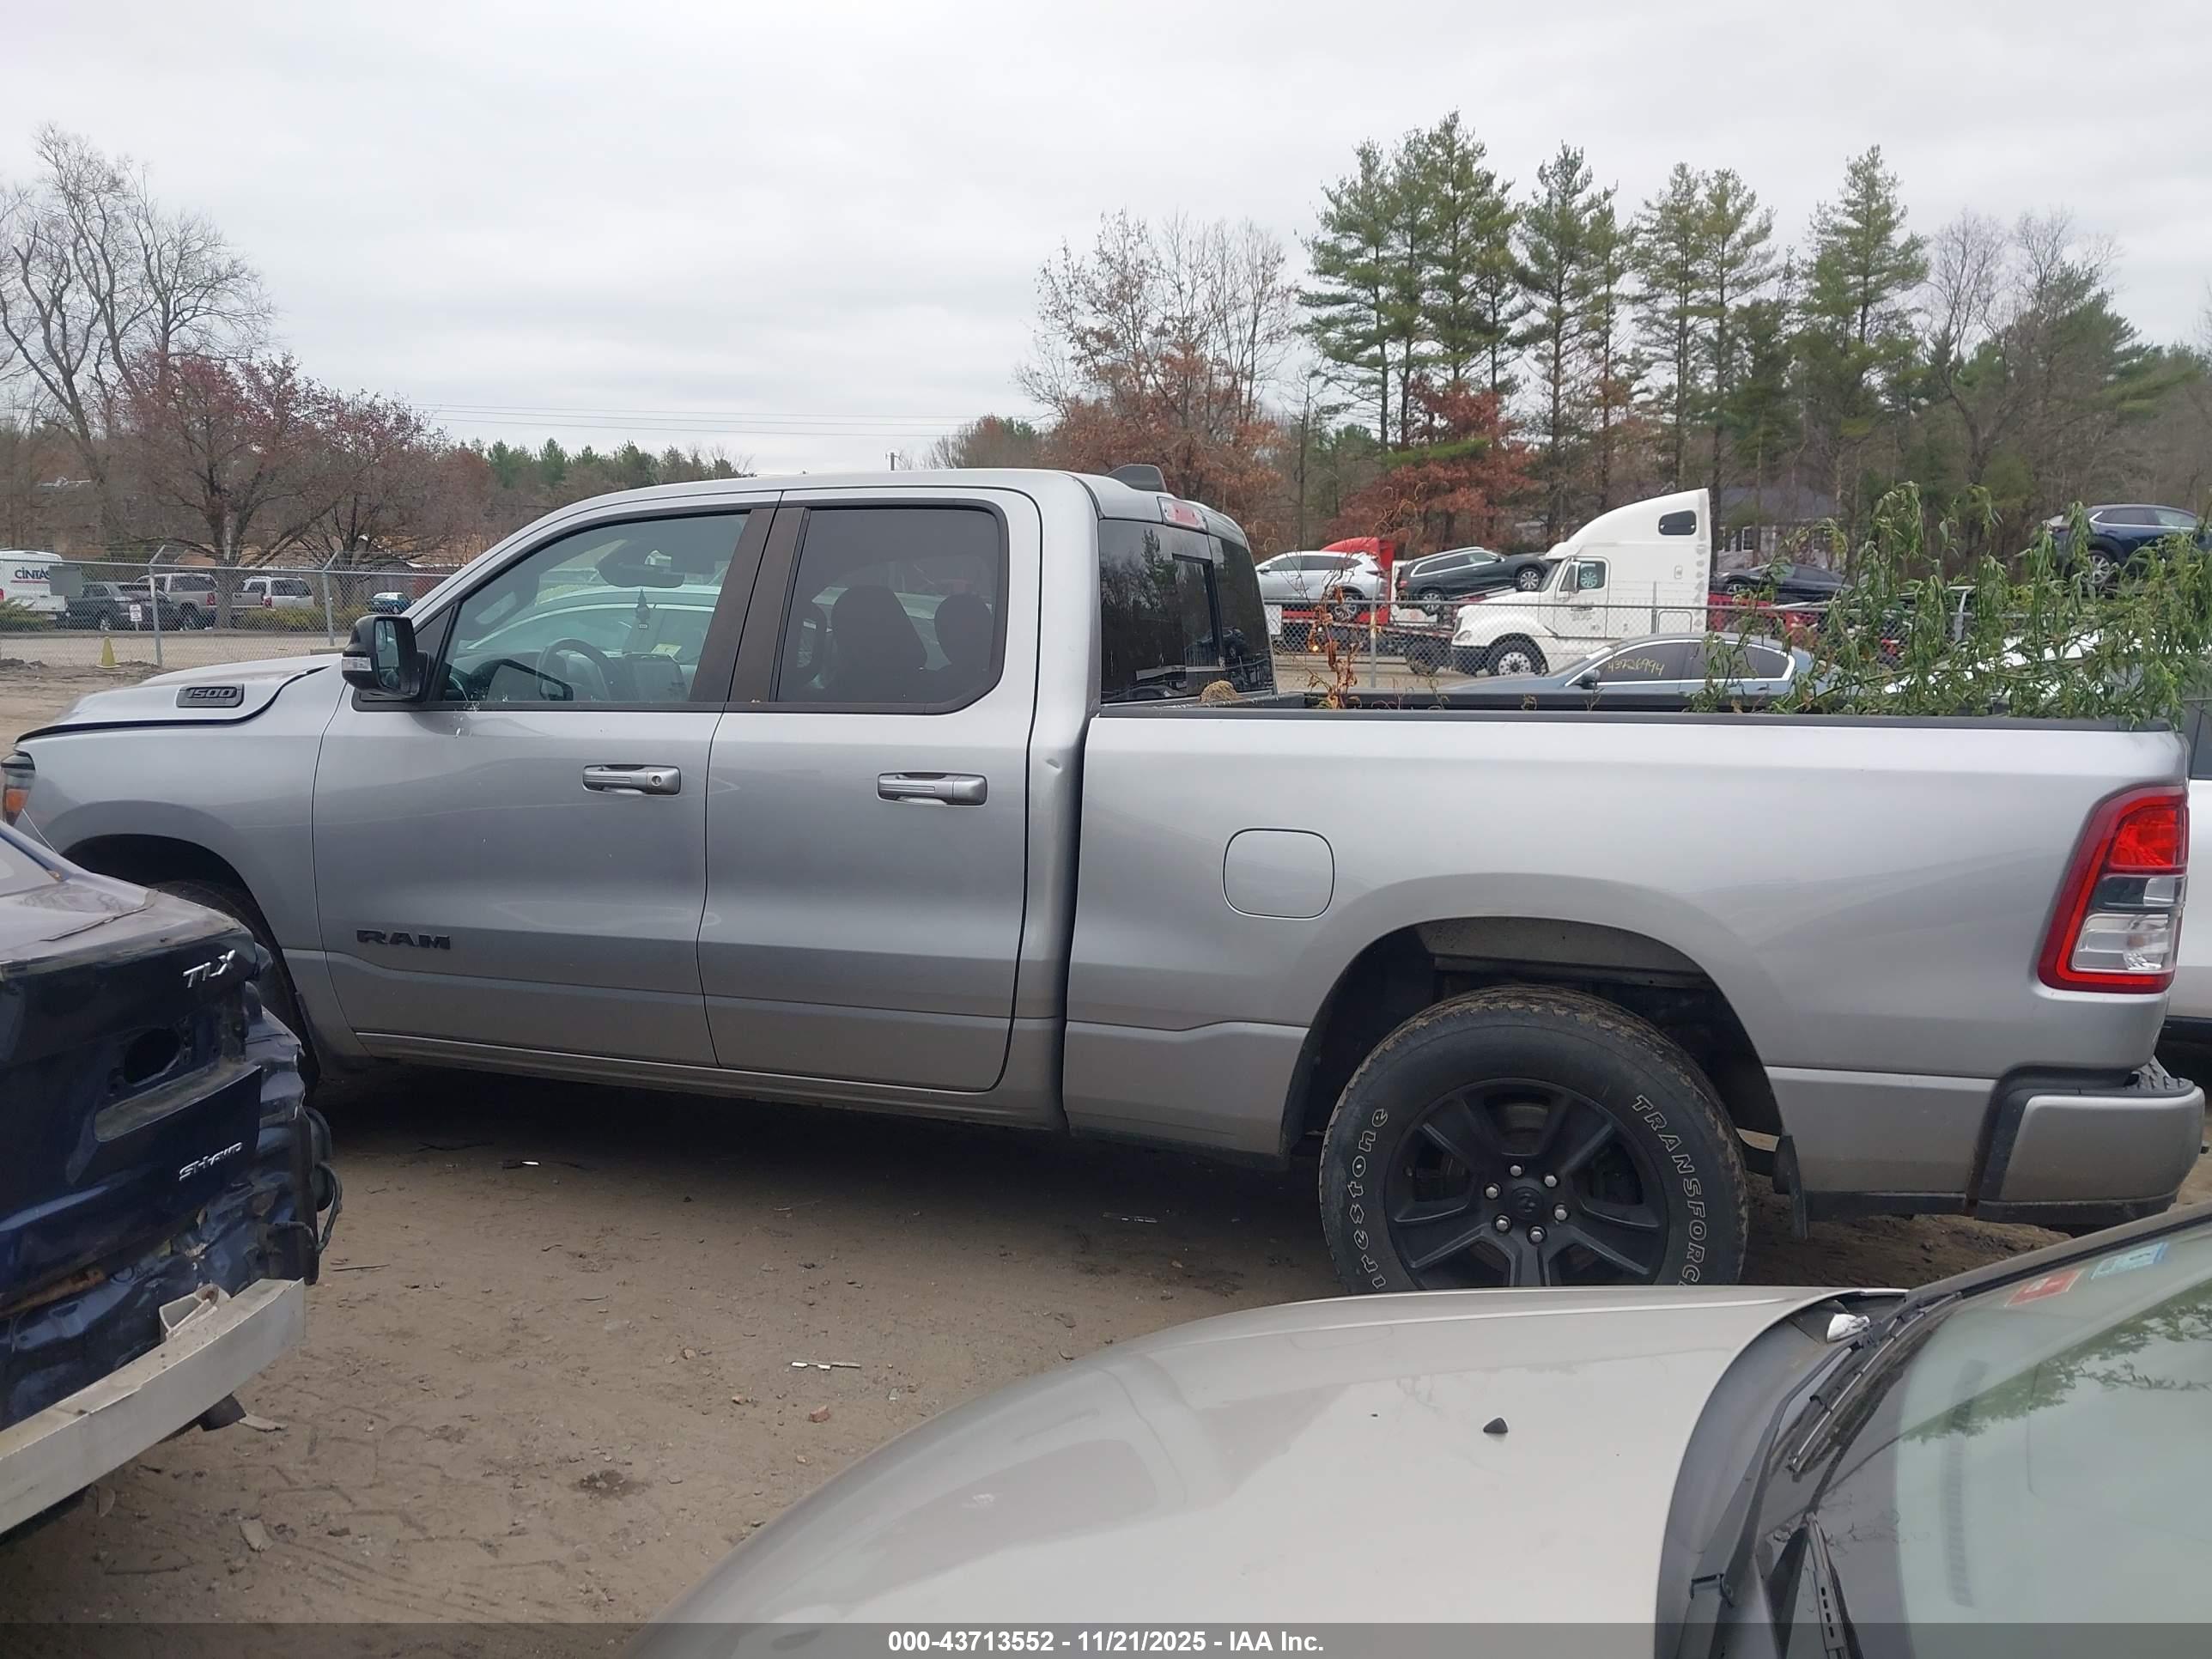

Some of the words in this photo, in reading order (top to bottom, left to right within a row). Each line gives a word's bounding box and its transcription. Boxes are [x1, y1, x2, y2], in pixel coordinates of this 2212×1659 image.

[187, 688, 235, 698] 1500
[356, 928, 451, 950] RAM
[183, 949, 236, 988] TLX
[1347, 1109, 1389, 1289] irestone
[1632, 1094, 1707, 1287] TRANSFORC
